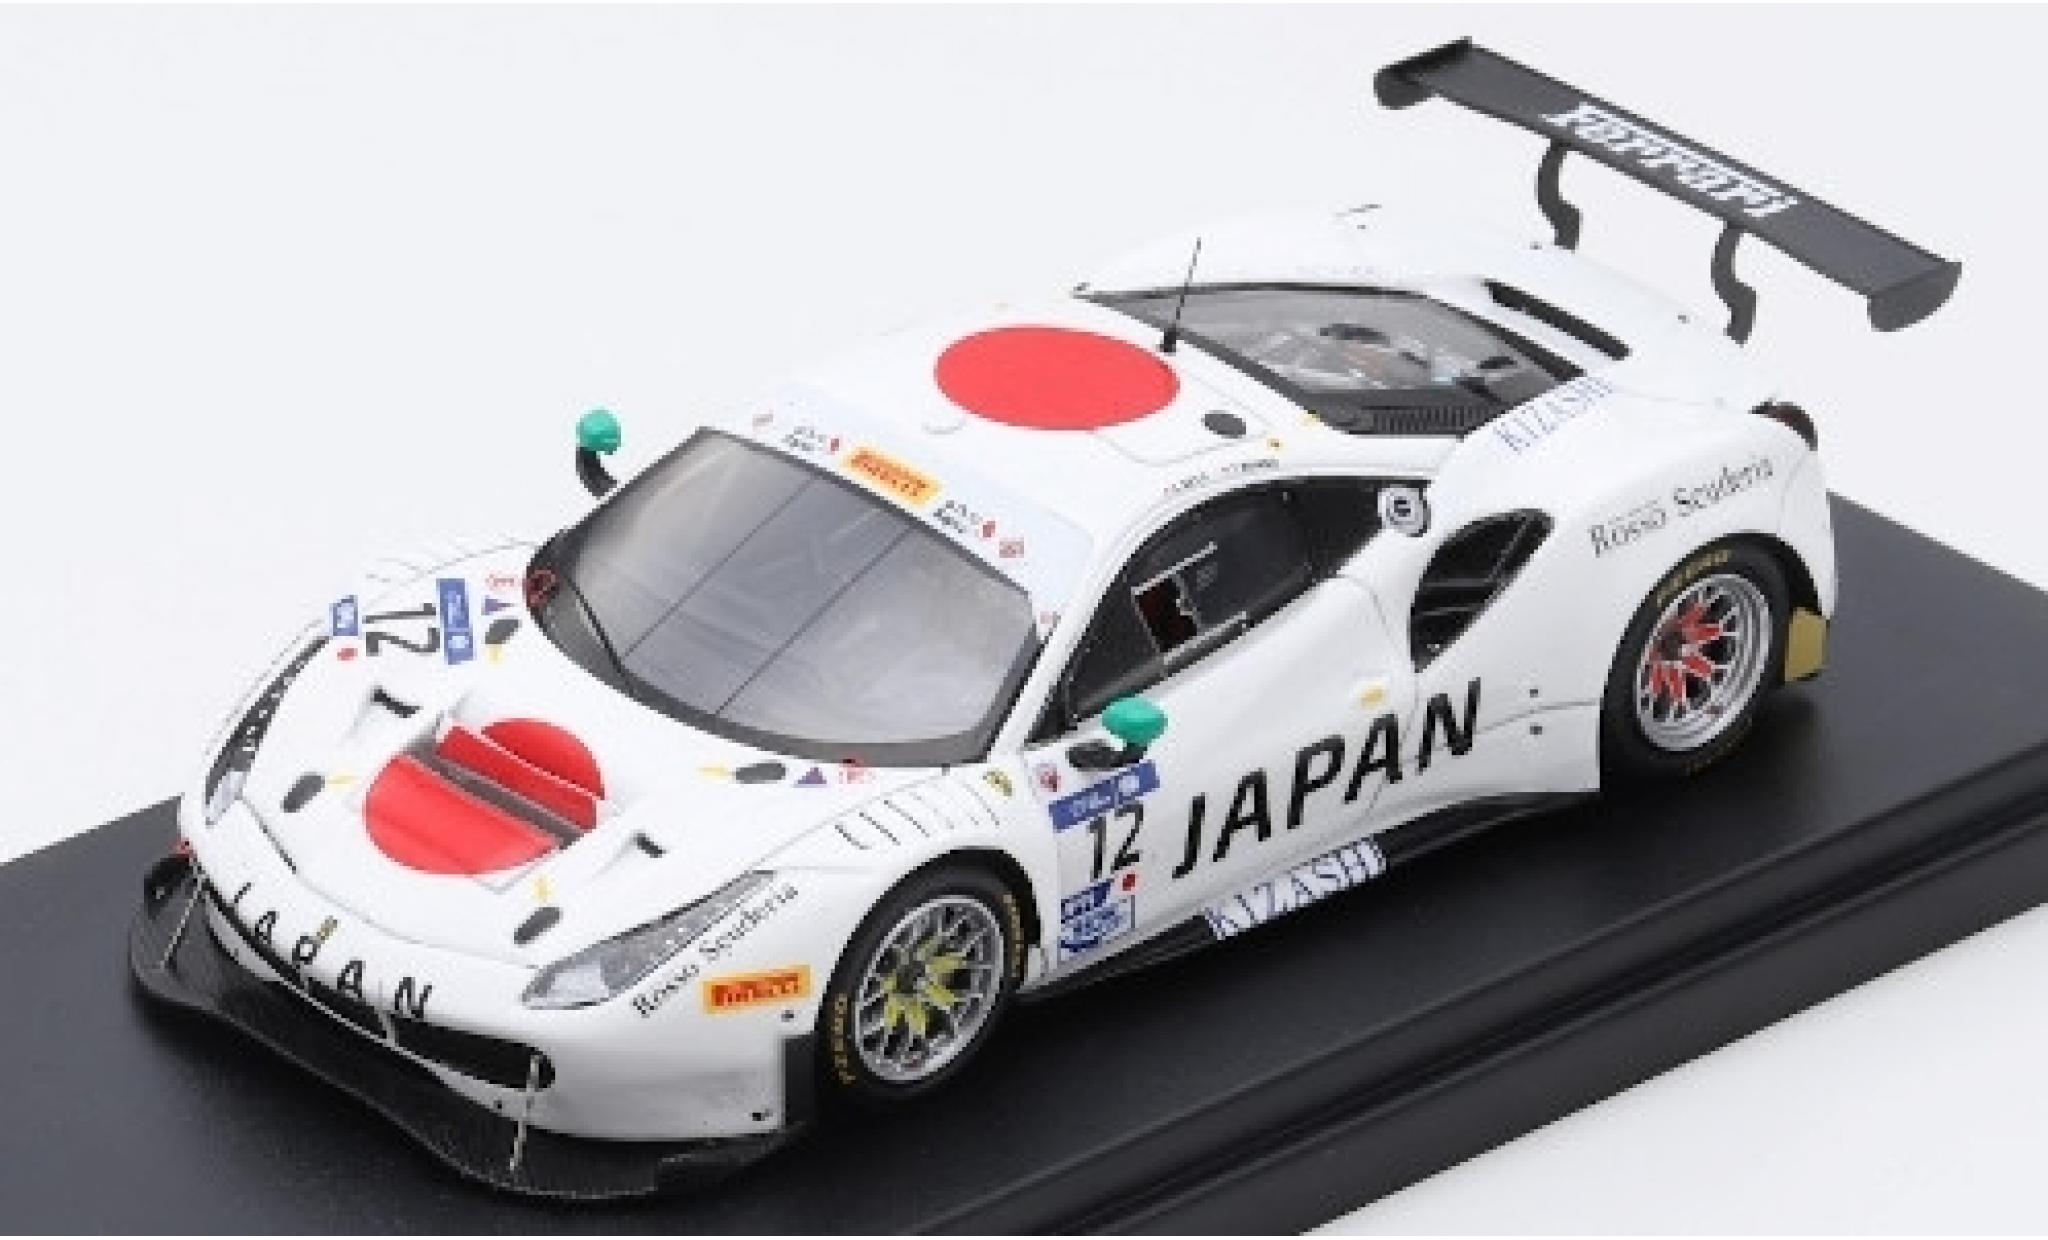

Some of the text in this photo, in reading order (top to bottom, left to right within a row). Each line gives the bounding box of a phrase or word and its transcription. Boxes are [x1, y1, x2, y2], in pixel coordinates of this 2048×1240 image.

[1543, 103, 1798, 217] Ferrari
[1589, 459, 1774, 557] Rosso Scuderia
[362, 602, 441, 657] 12
[1172, 677, 1481, 879] JAPAN
[1086, 803, 1145, 879] 12
[632, 886, 799, 1017] Rosso Scuderia
